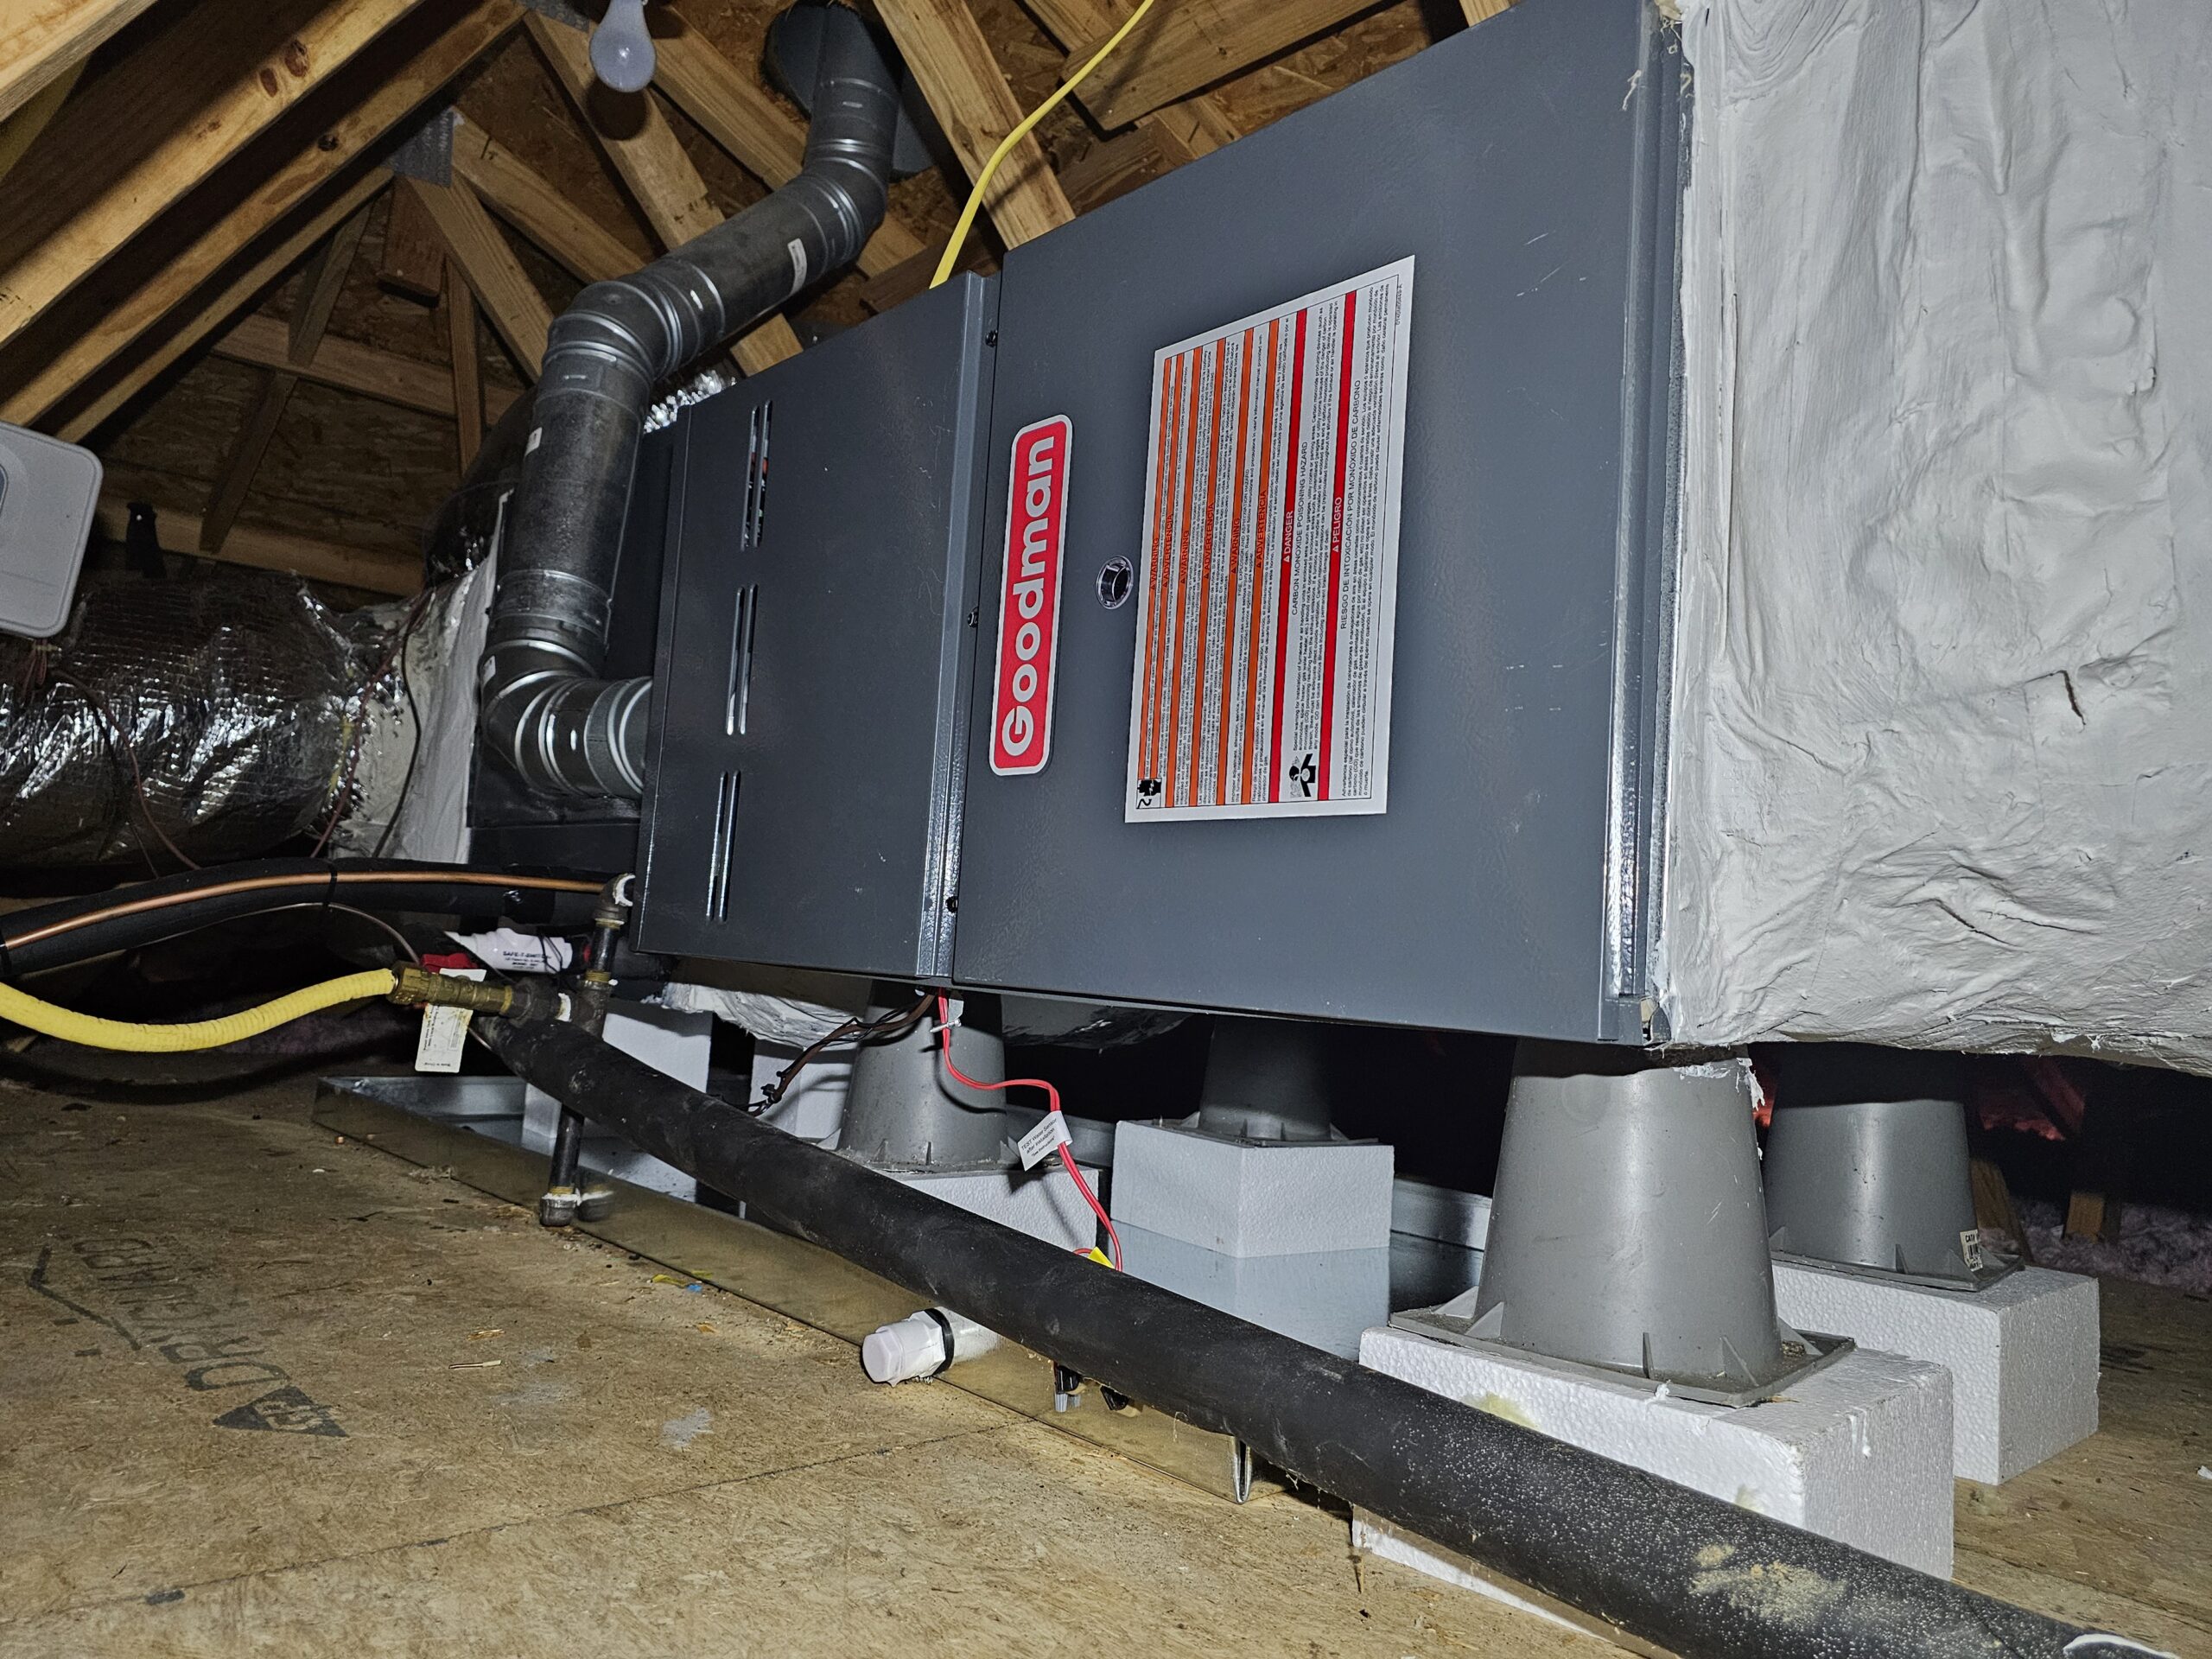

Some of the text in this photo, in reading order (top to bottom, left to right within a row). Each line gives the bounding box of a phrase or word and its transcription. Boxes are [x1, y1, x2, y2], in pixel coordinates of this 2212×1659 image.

[1352, 379, 1360, 425] CARBONO
[1351, 425, 1358, 439] DE
[1347, 439, 1357, 490] MONÓXIDO
[1256, 489, 1266, 560] ADVERTENCIA
[1296, 477, 1305, 528] POISONING
[1332, 496, 1342, 543] PELIGRO
[1163, 513, 1173, 580] ADVERTENCIA
[1180, 529, 1189, 576] WARNING
[1204, 502, 1213, 570] ADVERTENCIA
[1231, 517, 1239, 565] WARNING
[1284, 510, 1293, 554] DANGER
[1293, 528, 1302, 577] MONOXIDE
[1342, 512, 1353, 578] INTOXICACIÓN
[1150, 537, 1158, 582] WARNING
[1001, 436, 1054, 757] Goodman
[1291, 577, 1299, 615] CARBON
[1342, 578, 1349, 592] DE
[1340, 593, 1348, 629] RIESGO
[1021, 1139, 1032, 1150] TEST
[1043, 1118, 1056, 1132] Sensor
[72, 1236, 289, 1391] DRYGUARD
